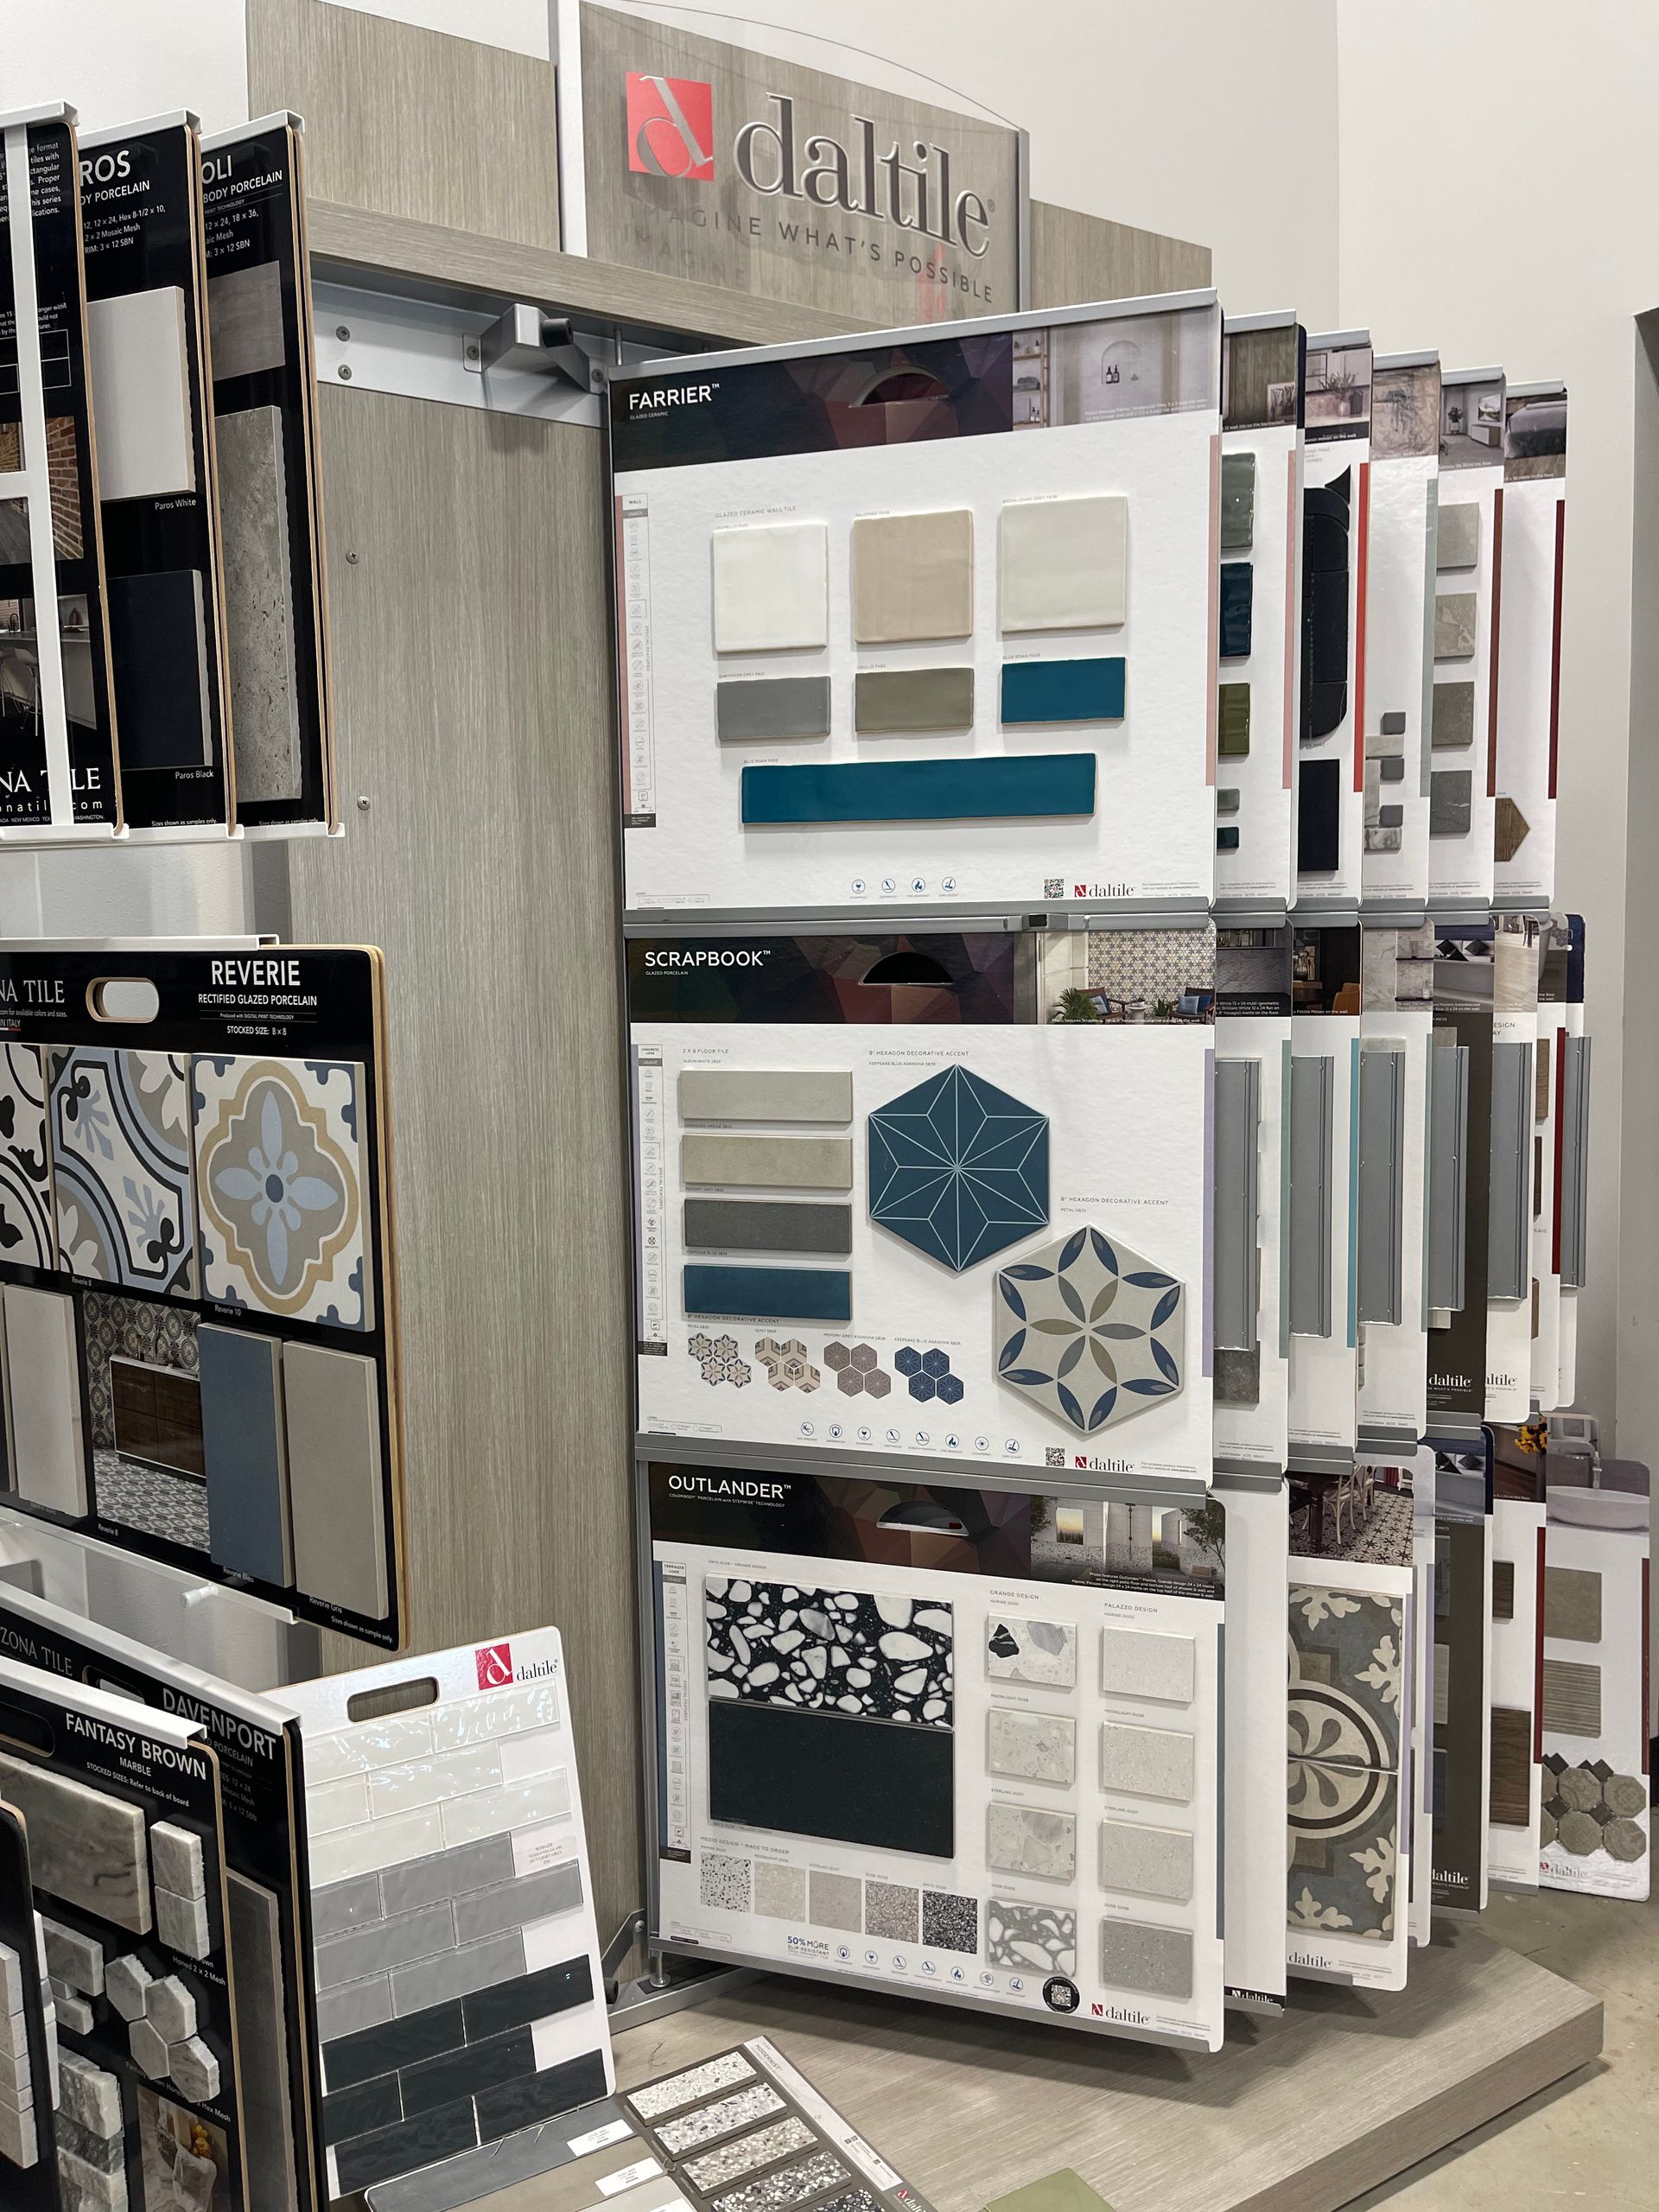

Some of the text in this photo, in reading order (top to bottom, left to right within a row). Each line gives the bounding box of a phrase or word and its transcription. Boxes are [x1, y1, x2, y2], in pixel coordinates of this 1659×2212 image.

[30, 152, 60, 164] tiles with
[201, 155, 232, 184] OLI
[38, 175, 60, 184] Proper
[203, 169, 283, 203] BODY PORCELAIN
[95, 180, 150, 202] PORCELAIN
[42, 196, 61, 205] series
[217, 199, 245, 212] TECHNOLOGY
[118, 205, 166, 222] Hex 8-1/2 10,
[232, 213, 240, 222] 18
[248, 208, 258, 219] 36,
[101, 223, 141, 238] Mosaic Mesh
[216, 229, 234, 242] Mesh
[120, 237, 134, 246] SBN
[226, 238, 251, 253] 12 SBN
[779, 220, 881, 262] WHAT'S
[894, 249, 994, 304] POSSIBLE
[629, 410, 669, 421] GLAZED CERAMIC
[155, 499, 197, 510] Paros White
[740, 508, 766, 517] CERAMIC
[175, 769, 214, 779] Paros Black
[211, 960, 301, 986] REVERIE
[23, 979, 66, 1004] TILE
[198, 993, 317, 1006] RECTIFIED GLAZED PORCELAIN
[7, 1019, 22, 1027] ITALY
[226, 1026, 287, 1036] STOCKED SIZE: 8 8
[214, 1304, 242, 1317] Reverie 10
[98, 1522, 114, 1535] Reverie
[223, 1565, 254, 1583] Reverie Bleu
[1016, 1592, 1039, 1600] DESIGN
[309, 1595, 342, 1614] Reverie Gris
[1104, 1602, 1133, 1611] PALAZZO
[331, 1615, 343, 1624] Sizes
[343, 1619, 359, 1630] shown
[365, 1627, 382, 1640] sample
[0, 1626, 38, 1660] ZONA
[41, 1646, 73, 1676] TILE
[1104, 1708, 1131, 1717] MOONLIGHT
[162, 1688, 276, 1760] DAVENPORT
[66, 1713, 136, 1754] FANTASY
[141, 1740, 207, 1780] BROWN
[213, 1740, 253, 1767] PORCELAIN
[119, 1757, 152, 1777] MARBLE
[86, 1762, 111, 1777] STOCKED
[112, 1770, 129, 1783] SIZES:
[130, 1778, 144, 1790] Refer
[152, 1784, 166, 1797] back
[166, 1791, 173, 1800] of
[173, 1794, 189, 1808] board
[787, 1936, 830, 1951] 50% MORE
[800, 1947, 830, 1956] RESISTANT
[173, 1955, 226, 1986] Honed Mesh
[201, 2102, 232, 2123] Hex Mesh
